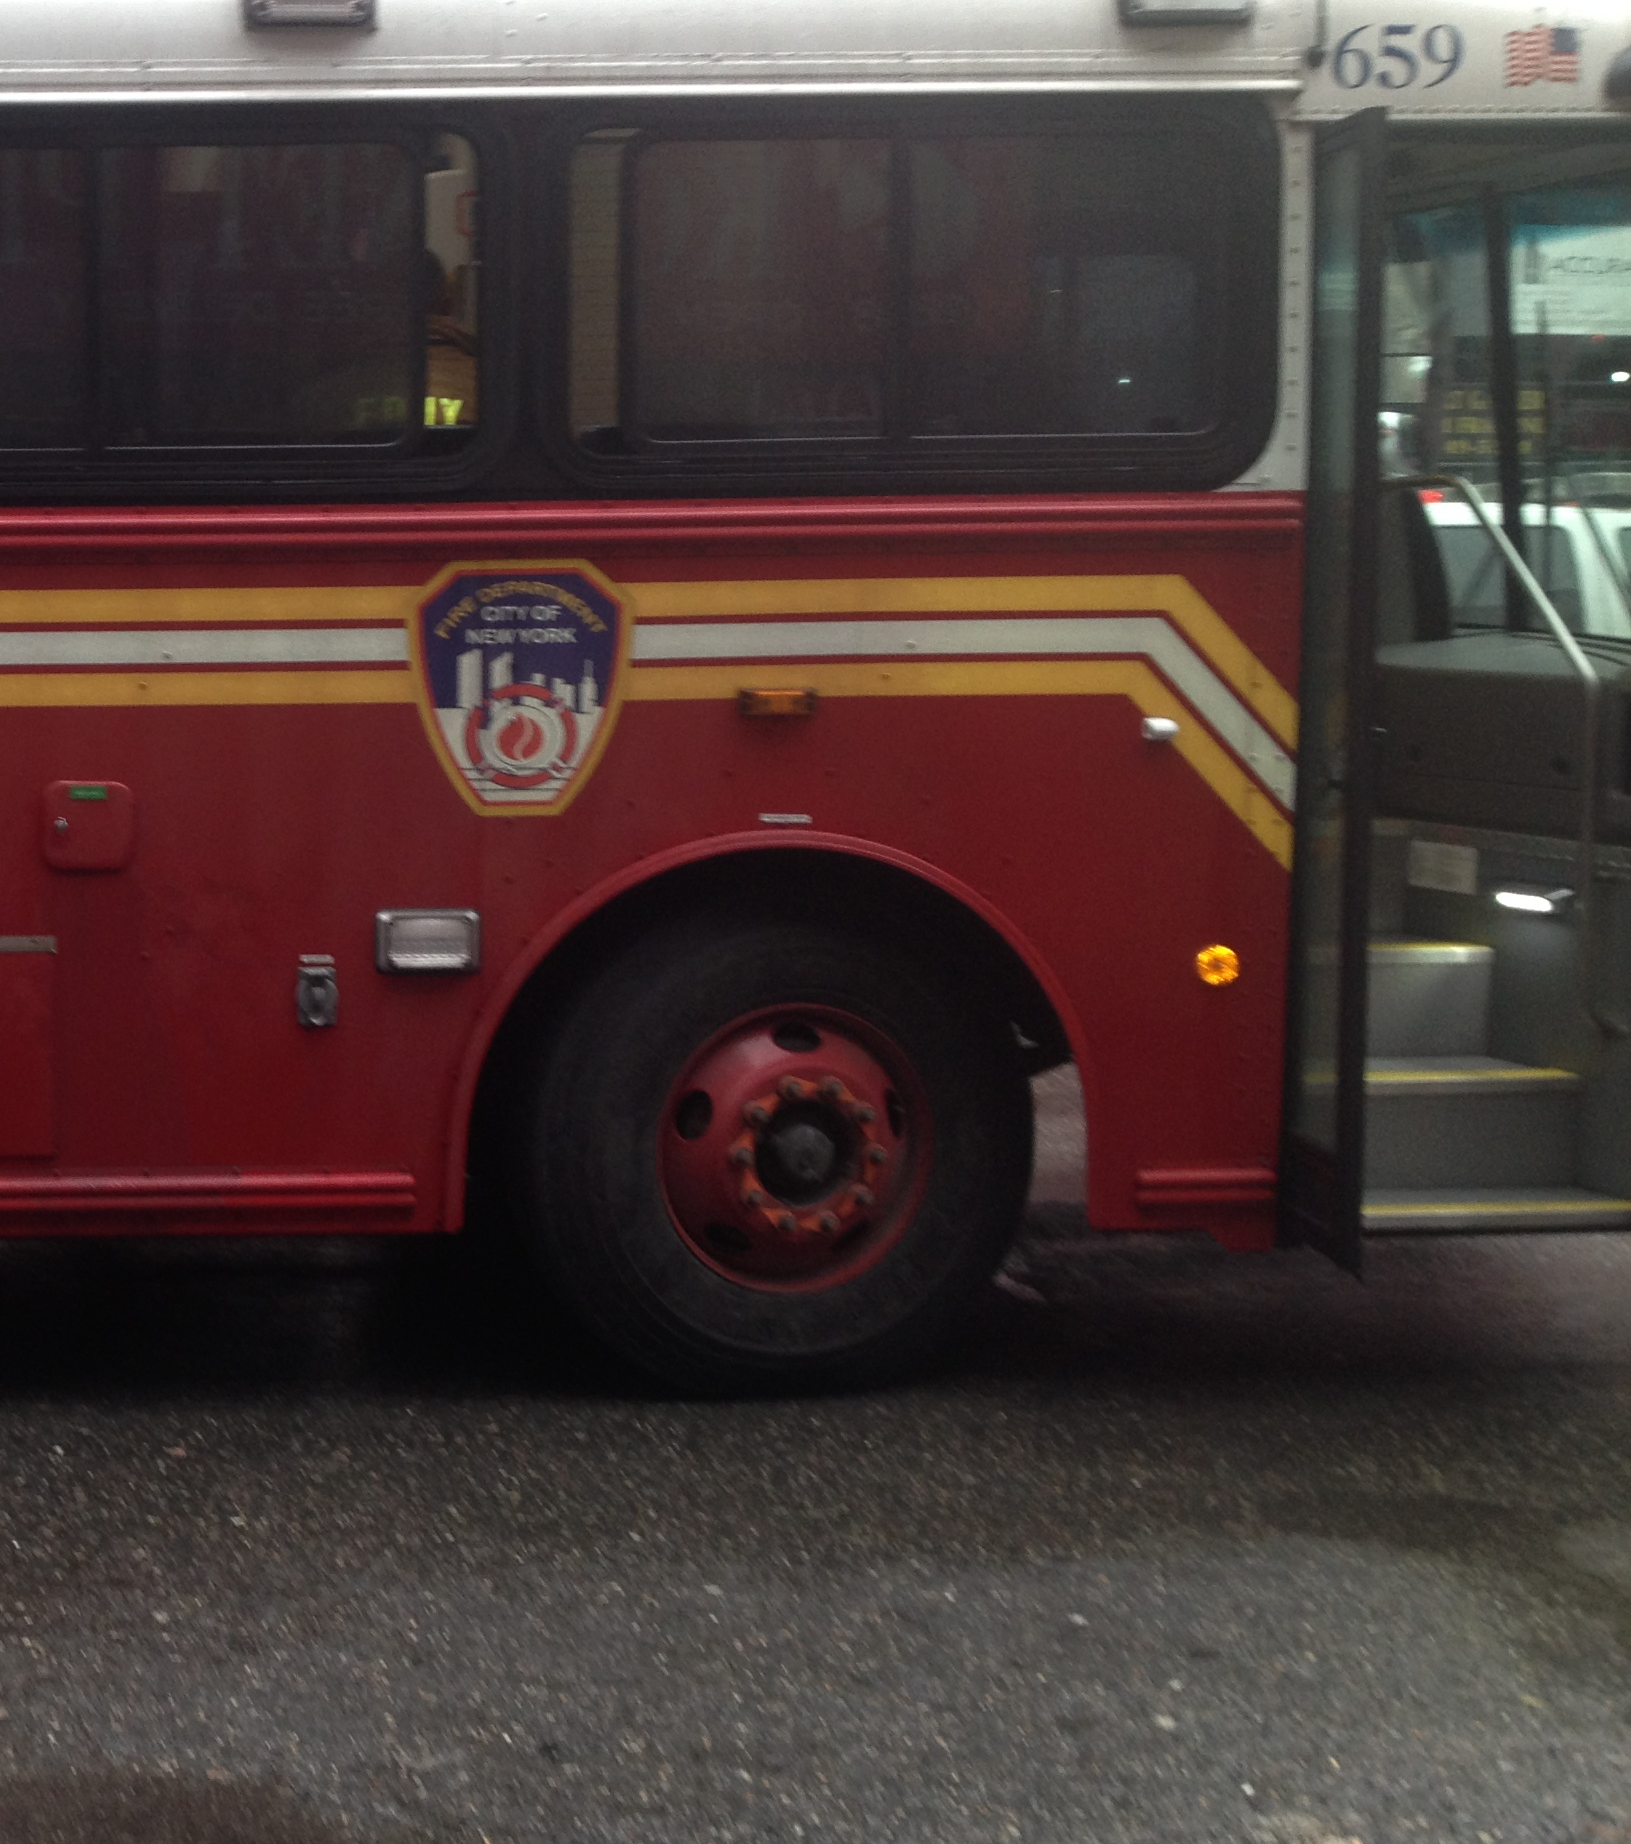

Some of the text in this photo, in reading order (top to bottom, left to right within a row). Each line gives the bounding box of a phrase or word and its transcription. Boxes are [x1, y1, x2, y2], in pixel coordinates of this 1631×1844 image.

[1332, 23, 1466, 90] 659
[530, 604, 562, 621] OF
[464, 627, 578, 644] NEW YORK
